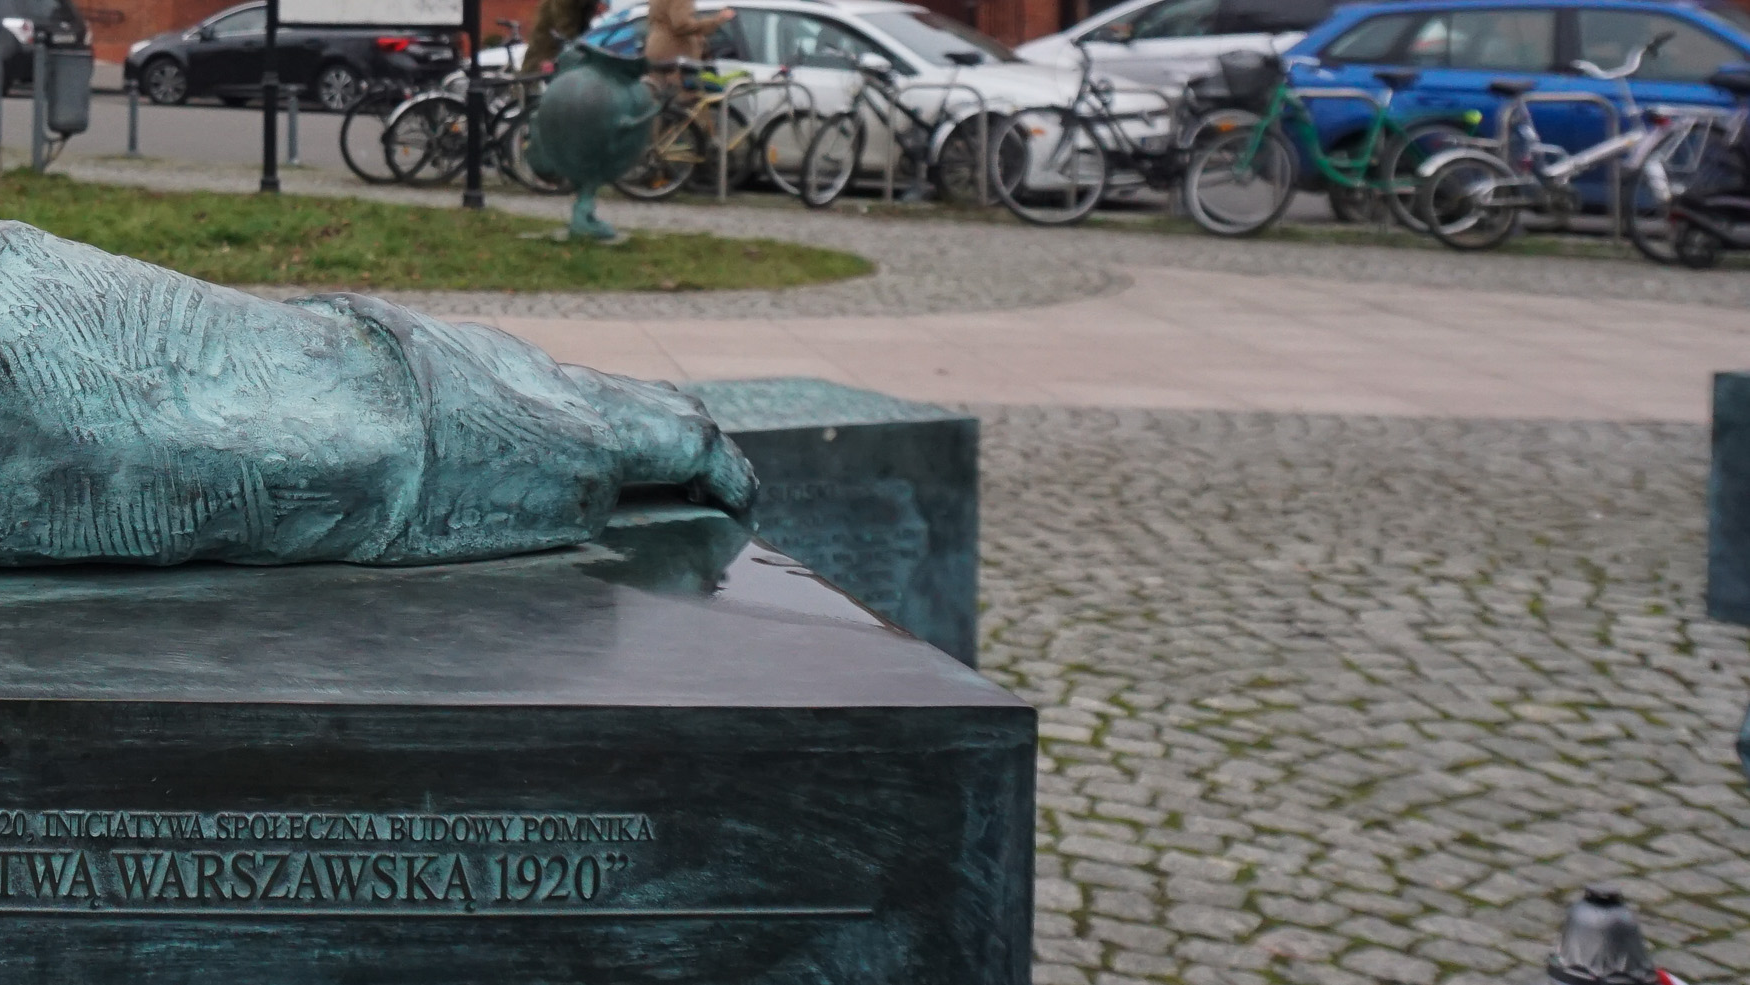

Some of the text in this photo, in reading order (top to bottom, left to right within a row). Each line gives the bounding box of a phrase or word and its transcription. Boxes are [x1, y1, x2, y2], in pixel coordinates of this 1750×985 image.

[42, 810, 204, 840] INICIATYWA
[214, 813, 378, 842] SPOŁECZNA
[389, 814, 514, 843] BUDOWY
[522, 814, 655, 843] POMNIKA
[112, 850, 476, 914] WARSZAWSKĄ
[494, 851, 630, 904] 1920”
